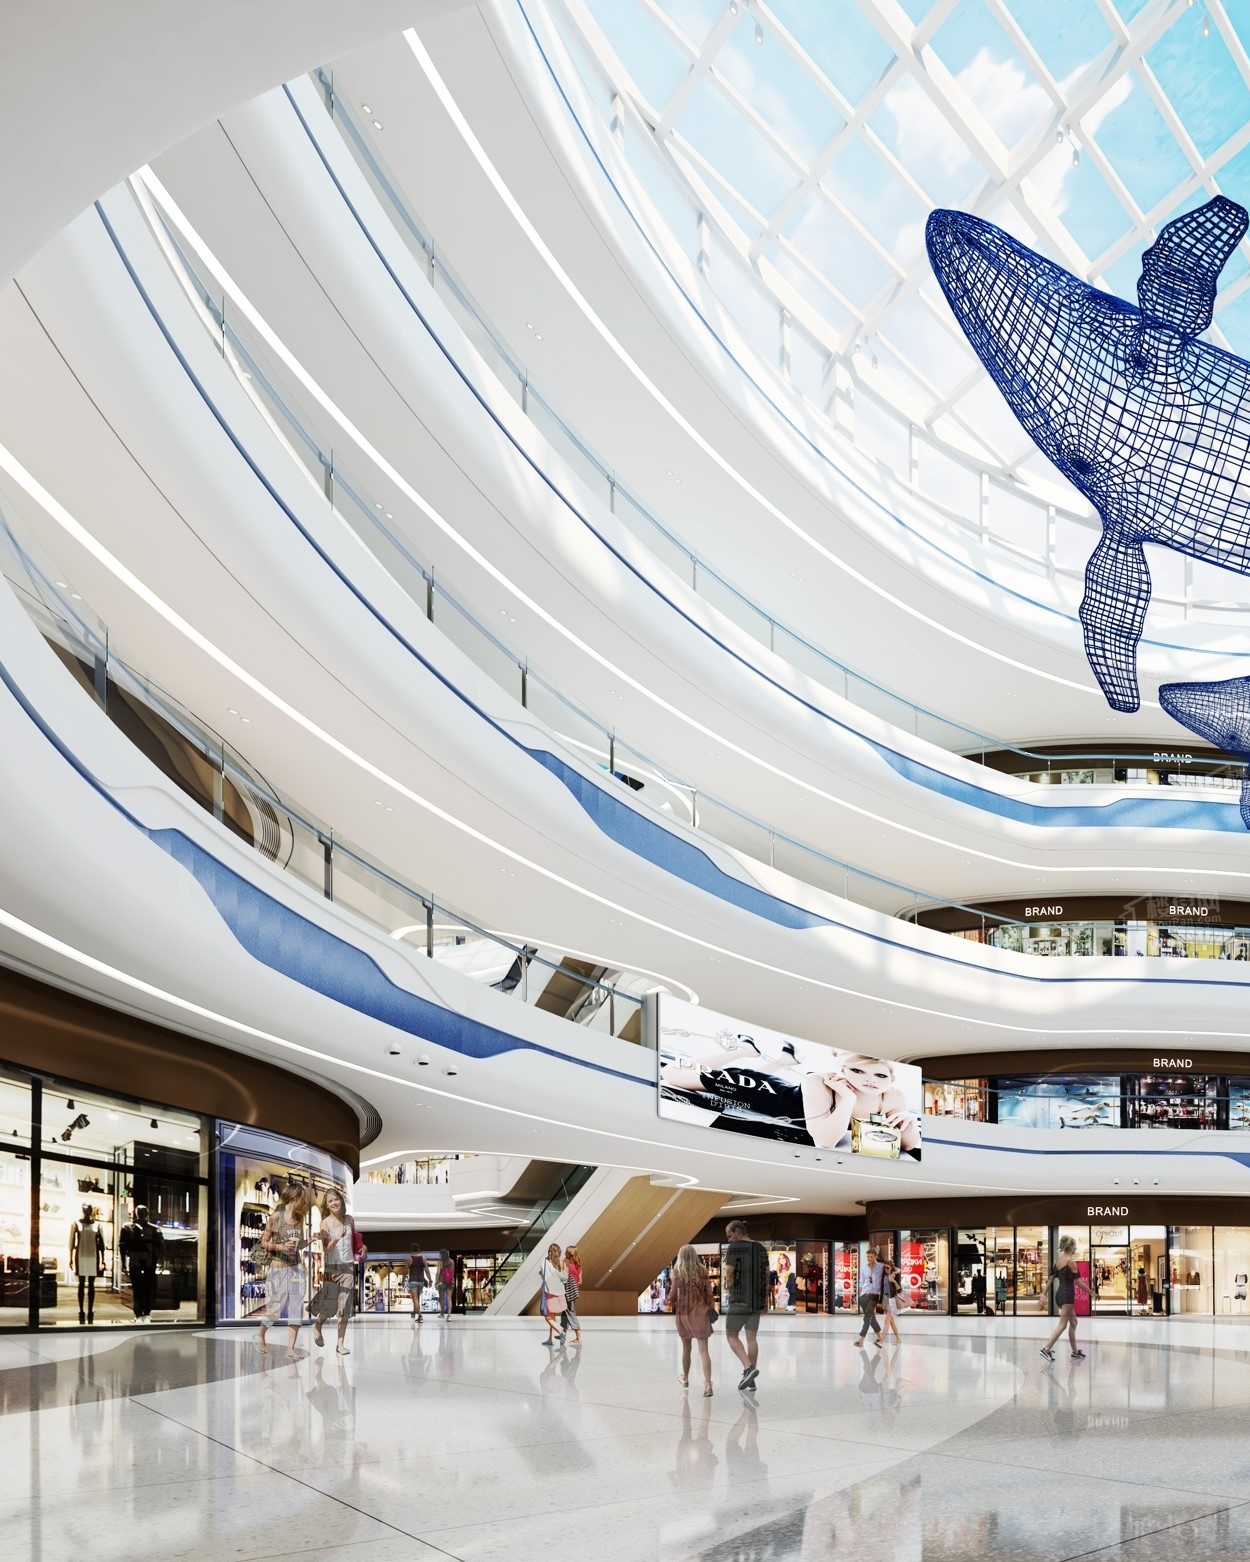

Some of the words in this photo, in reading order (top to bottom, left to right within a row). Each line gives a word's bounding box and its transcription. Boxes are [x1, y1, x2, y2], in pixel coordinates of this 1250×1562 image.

[1153, 752, 1193, 764] BRAND
[1025, 905, 1063, 917] BRAND
[1169, 905, 1209, 917] BRAND
[1153, 1058, 1193, 1068] BRAND
[678, 1058, 777, 1095] PRADA
[1087, 1206, 1129, 1216] BRAND
